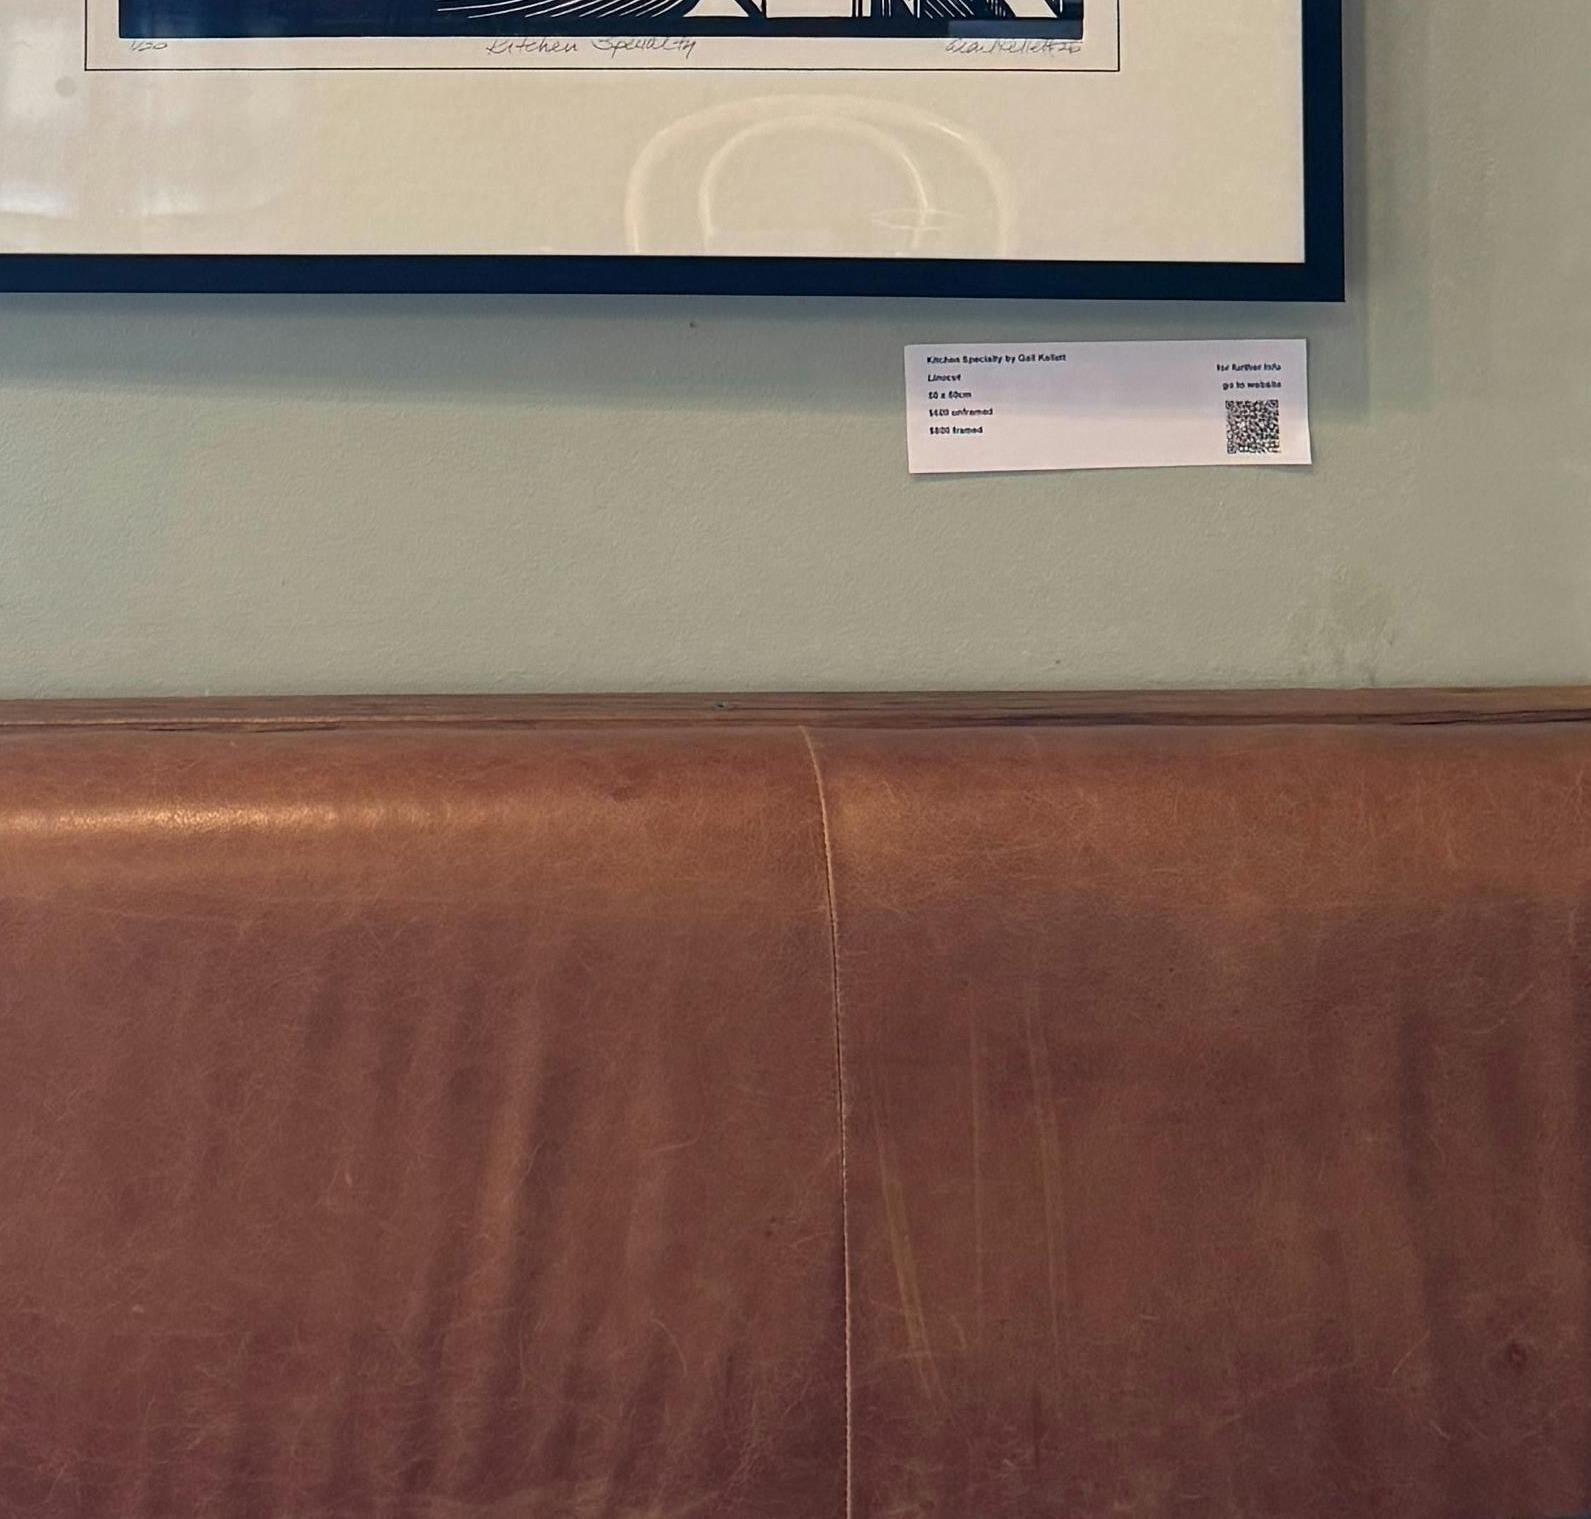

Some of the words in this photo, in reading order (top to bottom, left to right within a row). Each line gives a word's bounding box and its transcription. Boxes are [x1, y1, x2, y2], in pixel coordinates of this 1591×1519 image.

[486, 37, 578, 55] Kitchen
[926, 355, 960, 364] Kitchen
[1005, 354, 1015, 364] by
[1222, 382, 1234, 391] go
[1236, 381, 1245, 389] to
[951, 407, 994, 417] unframed
[952, 425, 984, 435] framed
